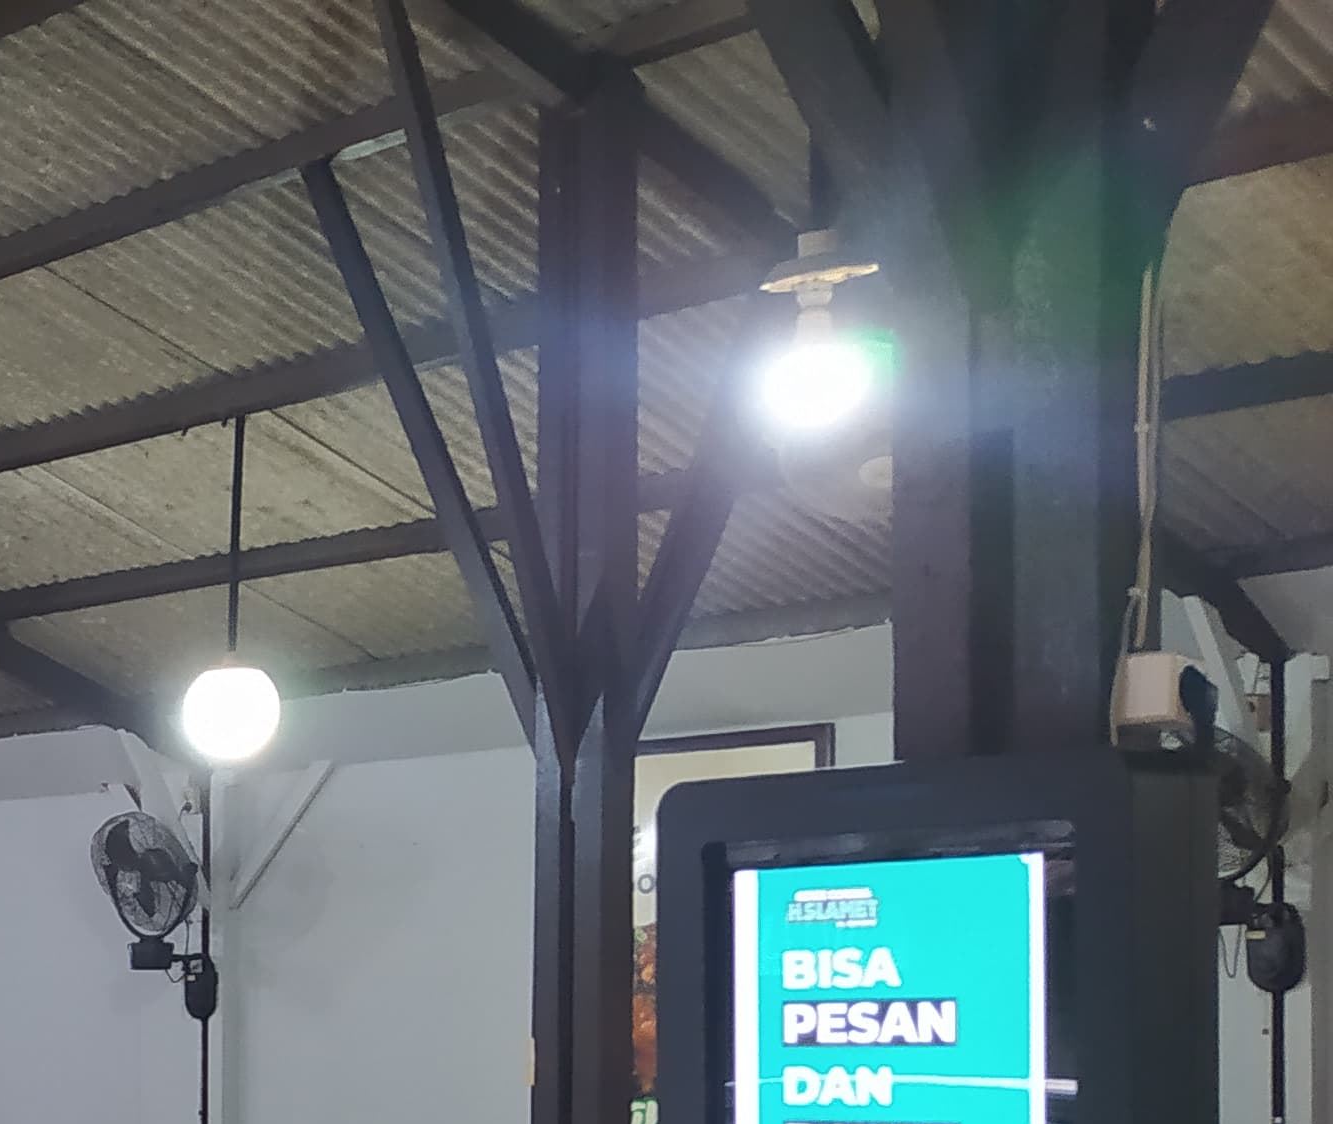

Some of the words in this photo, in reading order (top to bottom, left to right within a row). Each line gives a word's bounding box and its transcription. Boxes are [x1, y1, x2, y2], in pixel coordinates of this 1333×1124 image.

[782, 947, 901, 990] BISA
[783, 1001, 957, 1045] PESAN
[782, 1066, 893, 1106] DAN
